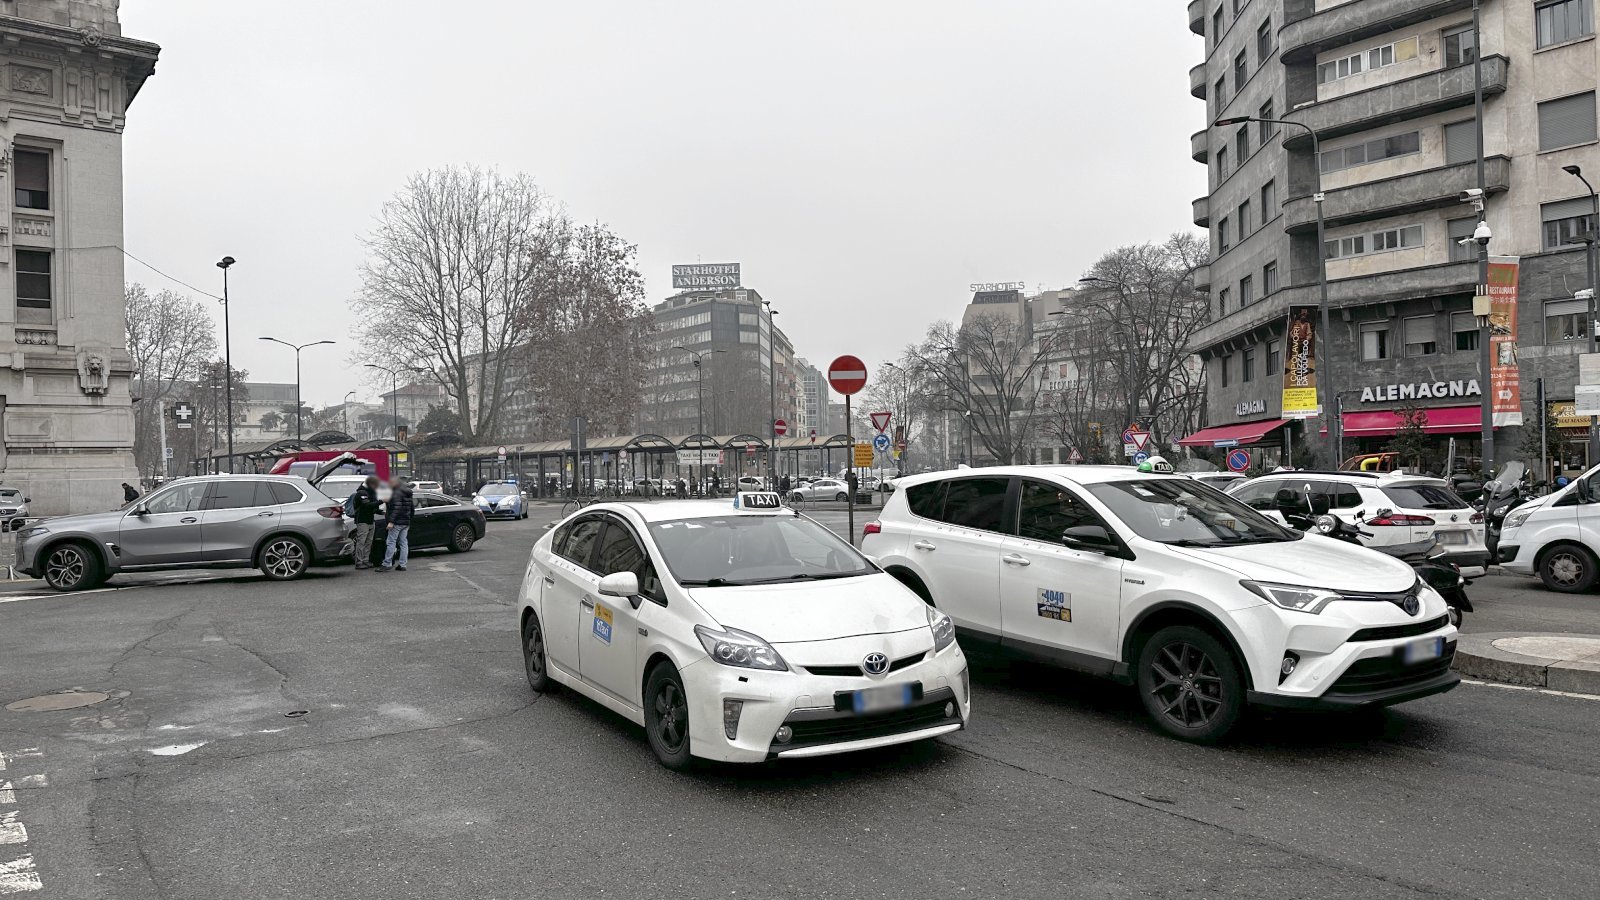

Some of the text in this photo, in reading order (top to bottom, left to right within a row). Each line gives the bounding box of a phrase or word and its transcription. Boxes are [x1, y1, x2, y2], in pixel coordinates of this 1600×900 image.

[673, 265, 739, 276] STARHOTEL
[676, 275, 736, 287] ANDERSON
[970, 281, 1025, 293] STARHOTELS
[1489, 286, 1516, 295] RESTAURANT
[1290, 325, 1301, 382] CAPOLAVORI
[1296, 353, 1304, 387] PELLIZZA
[1360, 379, 1482, 403] ALEMAGNA
[1236, 399, 1265, 416] ALEMAGNA
[748, 494, 777, 506] TAXI
